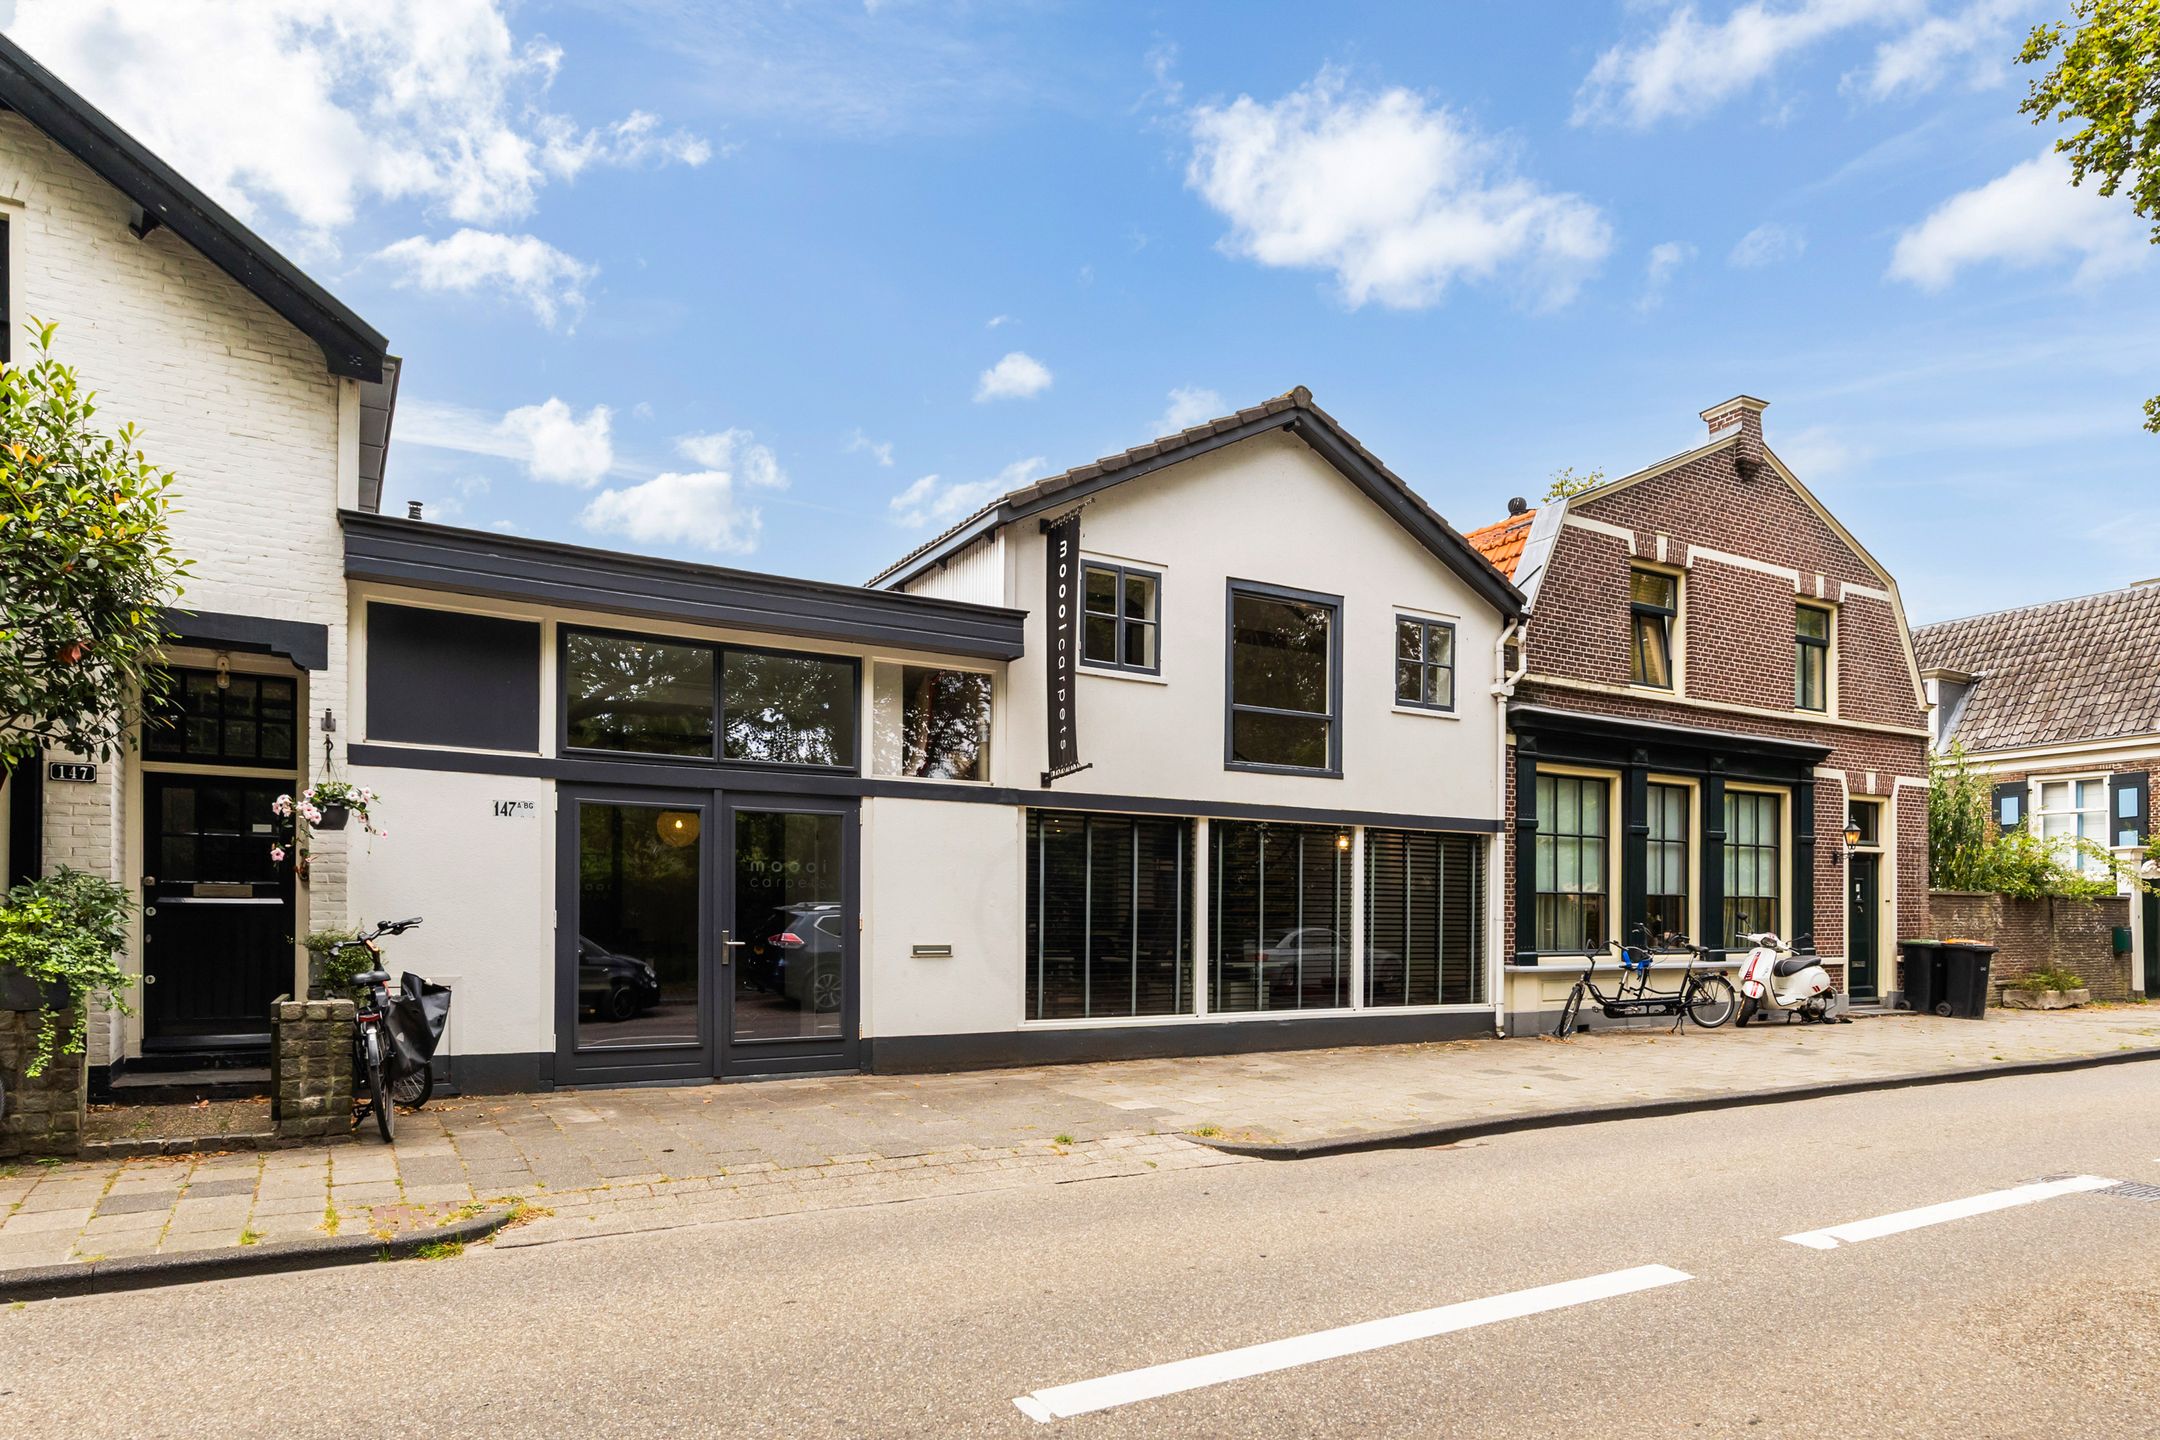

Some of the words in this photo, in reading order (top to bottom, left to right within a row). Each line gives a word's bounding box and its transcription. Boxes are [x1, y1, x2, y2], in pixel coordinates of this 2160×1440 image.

[1058, 540, 1068, 631] moooi
[1056, 638, 1067, 750] carpets
[59, 766, 88, 780] 147
[494, 801, 516, 816] 147
[750, 859, 827, 873] moooi
